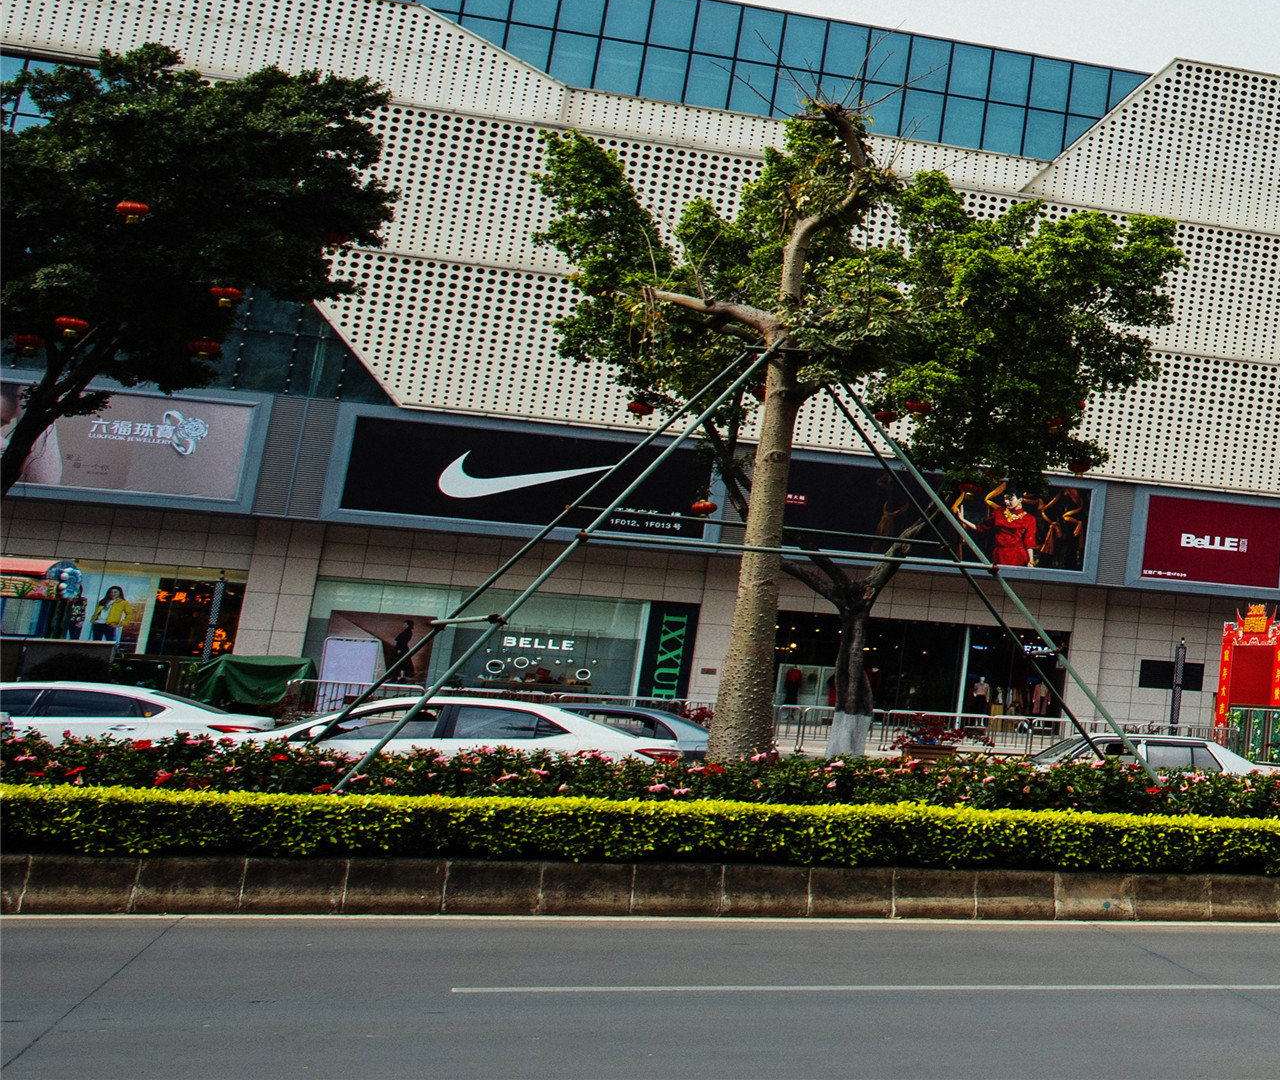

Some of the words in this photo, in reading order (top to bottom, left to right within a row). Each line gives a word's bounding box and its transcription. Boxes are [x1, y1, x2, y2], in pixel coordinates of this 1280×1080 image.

[90, 418, 175, 439] 六福珠寶
[503, 636, 575, 651] BELLE
